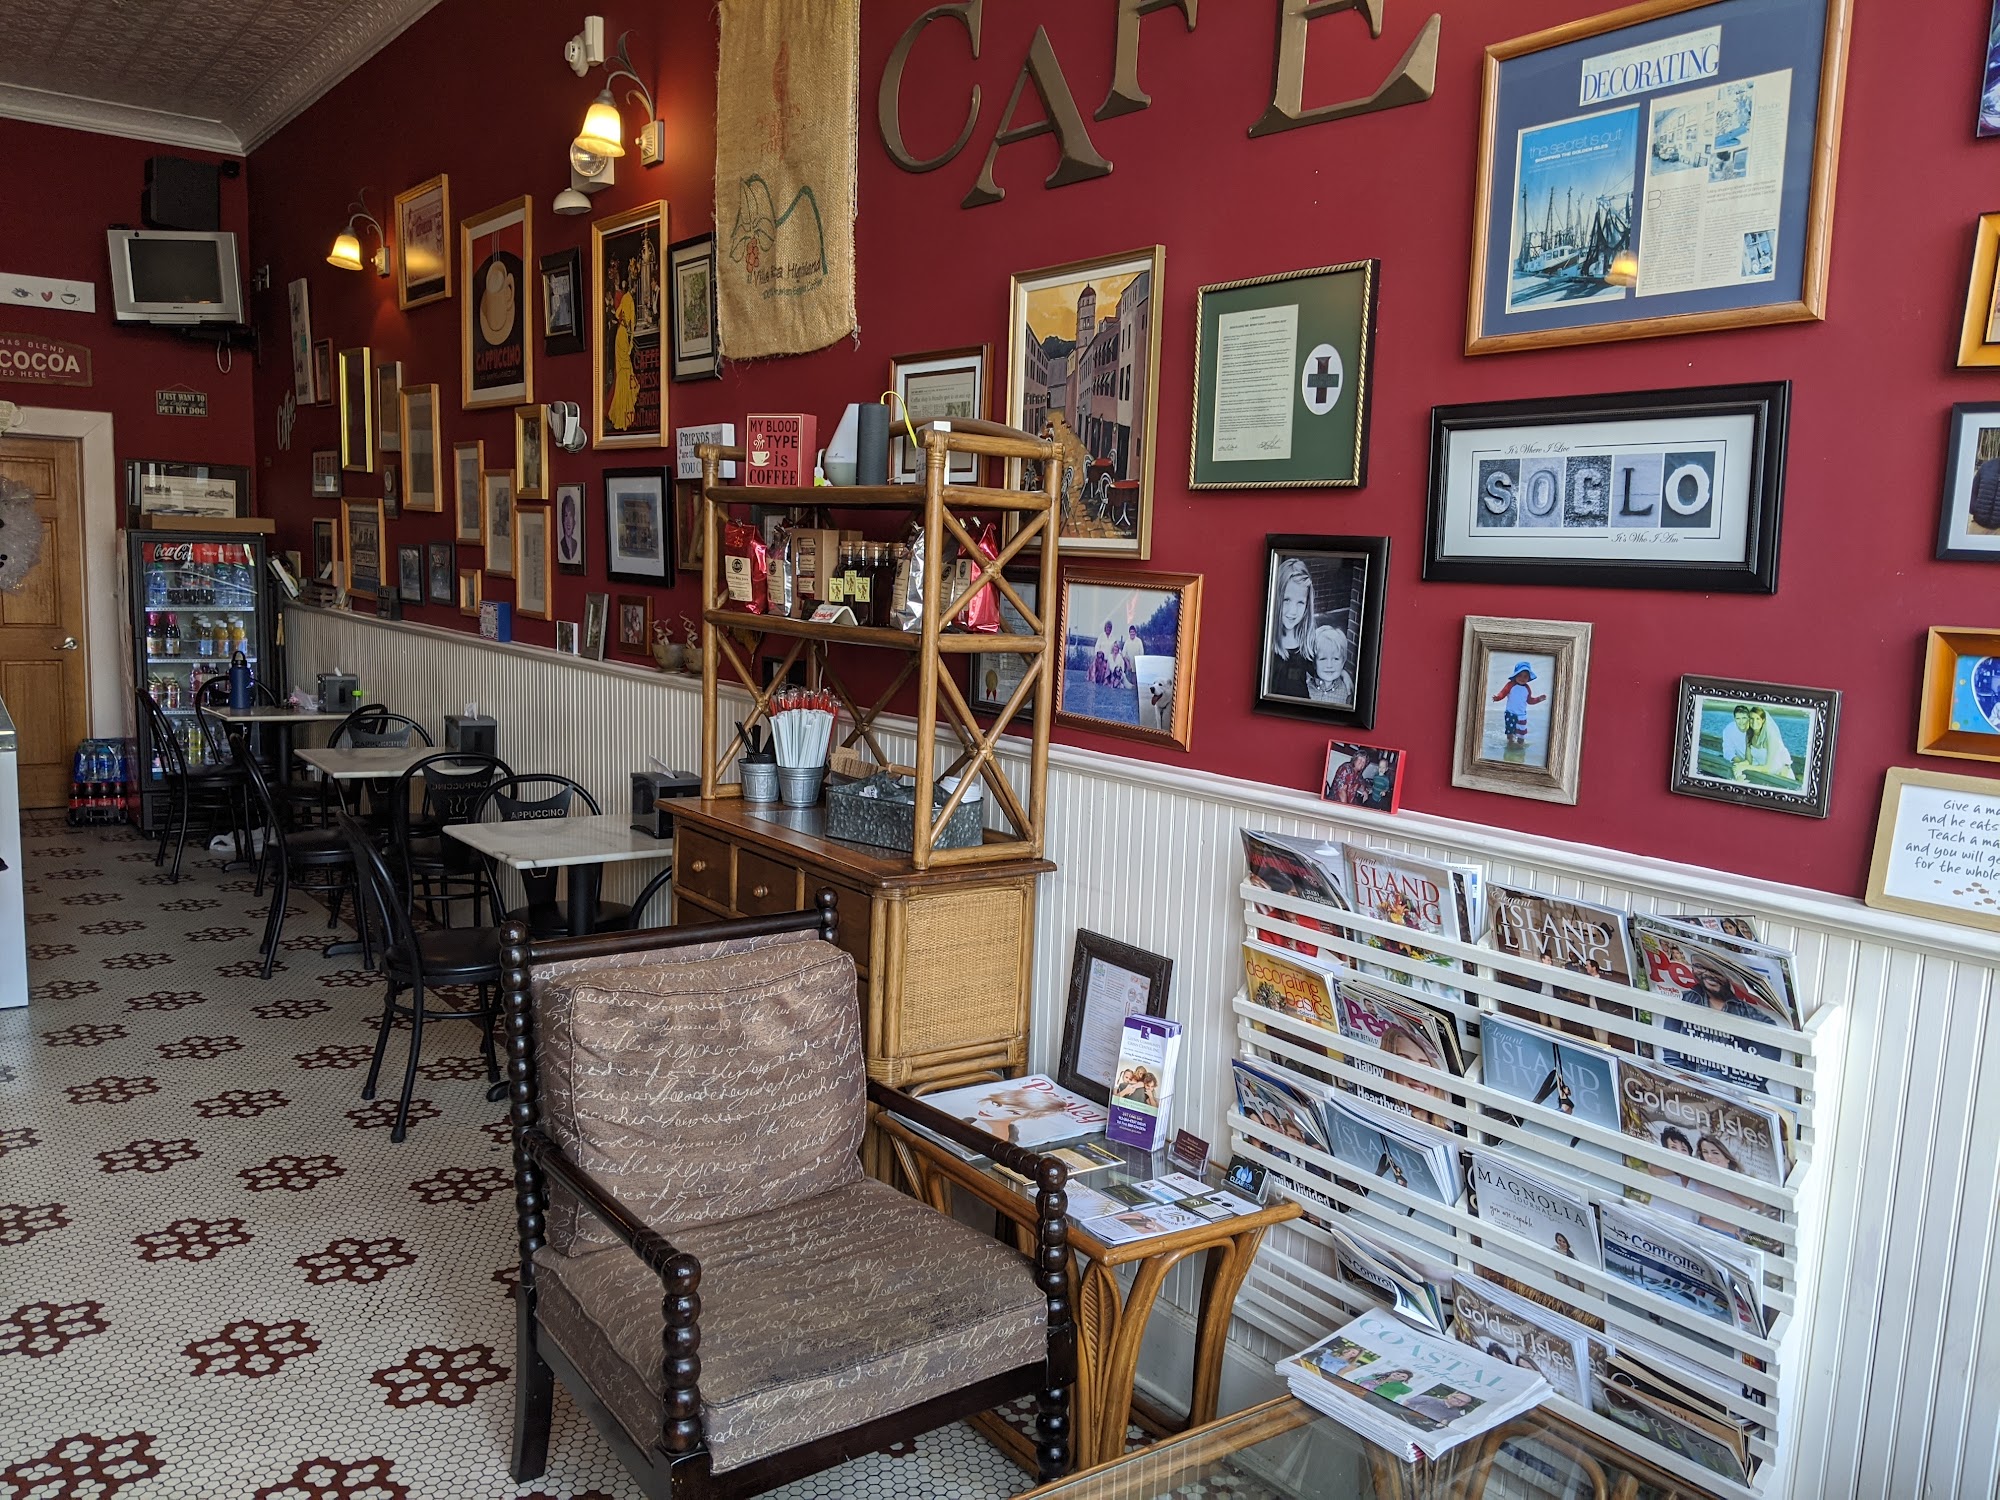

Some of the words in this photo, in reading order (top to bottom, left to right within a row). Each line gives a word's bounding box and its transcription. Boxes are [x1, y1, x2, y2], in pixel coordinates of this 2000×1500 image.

[1583, 43, 1719, 102] DECORATING
[1529, 144, 1548, 159] the
[1549, 135, 1588, 155] secret
[1590, 134, 1599, 146] is
[1601, 128, 1622, 143] out
[28, 341, 65, 353] BLEND
[0, 368, 15, 376] ED
[20, 370, 47, 378] HERE
[163, 393, 176, 401] JUST
[178, 393, 195, 402] WANT
[196, 394, 205, 402] TO
[159, 405, 174, 414] PET
[175, 406, 187, 414] MY
[189, 407, 206, 415] DOG
[750, 420, 764, 432] MY
[766, 420, 798, 433] BLOOD
[680, 431, 710, 447] FRIENDS
[766, 435, 798, 449] TYPE
[1504, 444, 1519, 455] It's
[1519, 442, 1543, 454] Where
[1552, 441, 1571, 453] Live
[681, 462, 696, 474] YOU
[774, 451, 788, 467] is
[750, 469, 797, 486] COFFEE
[1484, 462, 1711, 518] SOGLO
[1610, 532, 1626, 544] It's
[1628, 531, 1648, 543] Who
[1660, 532, 1679, 544] Am
[505, 808, 565, 821] APPUCCINO
[1943, 799, 1970, 812] Give
[1973, 804, 1981, 814] a
[1985, 807, 2000, 816] ma
[1922, 813, 1948, 828] and
[1950, 814, 1966, 828] he
[1969, 818, 2000, 832] eats
[1927, 828, 1966, 843] Teach
[1969, 835, 1978, 846] a
[1981, 838, 2000, 849] ma
[1905, 842, 1931, 856] and
[1933, 846, 1958, 859] you
[1961, 850, 1984, 863] will
[1987, 855, 2000, 868] ge
[1914, 856, 1935, 870] for
[1939, 860, 1962, 874] the
[1965, 865, 2000, 881] whole
[1351, 861, 1441, 904] ISLAND
[1353, 881, 1442, 927] LIVNG
[1488, 886, 1533, 908] Elegant
[1500, 901, 1610, 948] ISLAND
[1500, 923, 1613, 972] LIVING
[1246, 958, 1319, 996] decorating
[1284, 986, 1333, 1020] basics
[1350, 1031, 1360, 1040] NEW
[1482, 1019, 1524, 1044] Elegant
[1353, 1058, 1386, 1079] Happy
[1491, 1036, 1601, 1092] ISLAND
[1492, 1058, 1601, 1115] LIVG
[1356, 1081, 1413, 1117] Heartbreak
[1624, 1077, 1712, 1130] Golden
[1718, 1109, 1770, 1149] Isles
[1293, 1181, 1331, 1207] Divided
[1477, 1166, 1587, 1228] MAGNOLIA
[1513, 1194, 1552, 1217] JOURNAL
[1489, 1205, 1501, 1216] you
[1502, 1210, 1511, 1219] are
[1512, 1215, 1534, 1228] capable
[1631, 1234, 1706, 1277] Controller
[1456, 1295, 1525, 1348] Golden
[1530, 1333, 1574, 1371] Isles
[1359, 1317, 1507, 1393] COASTAL
